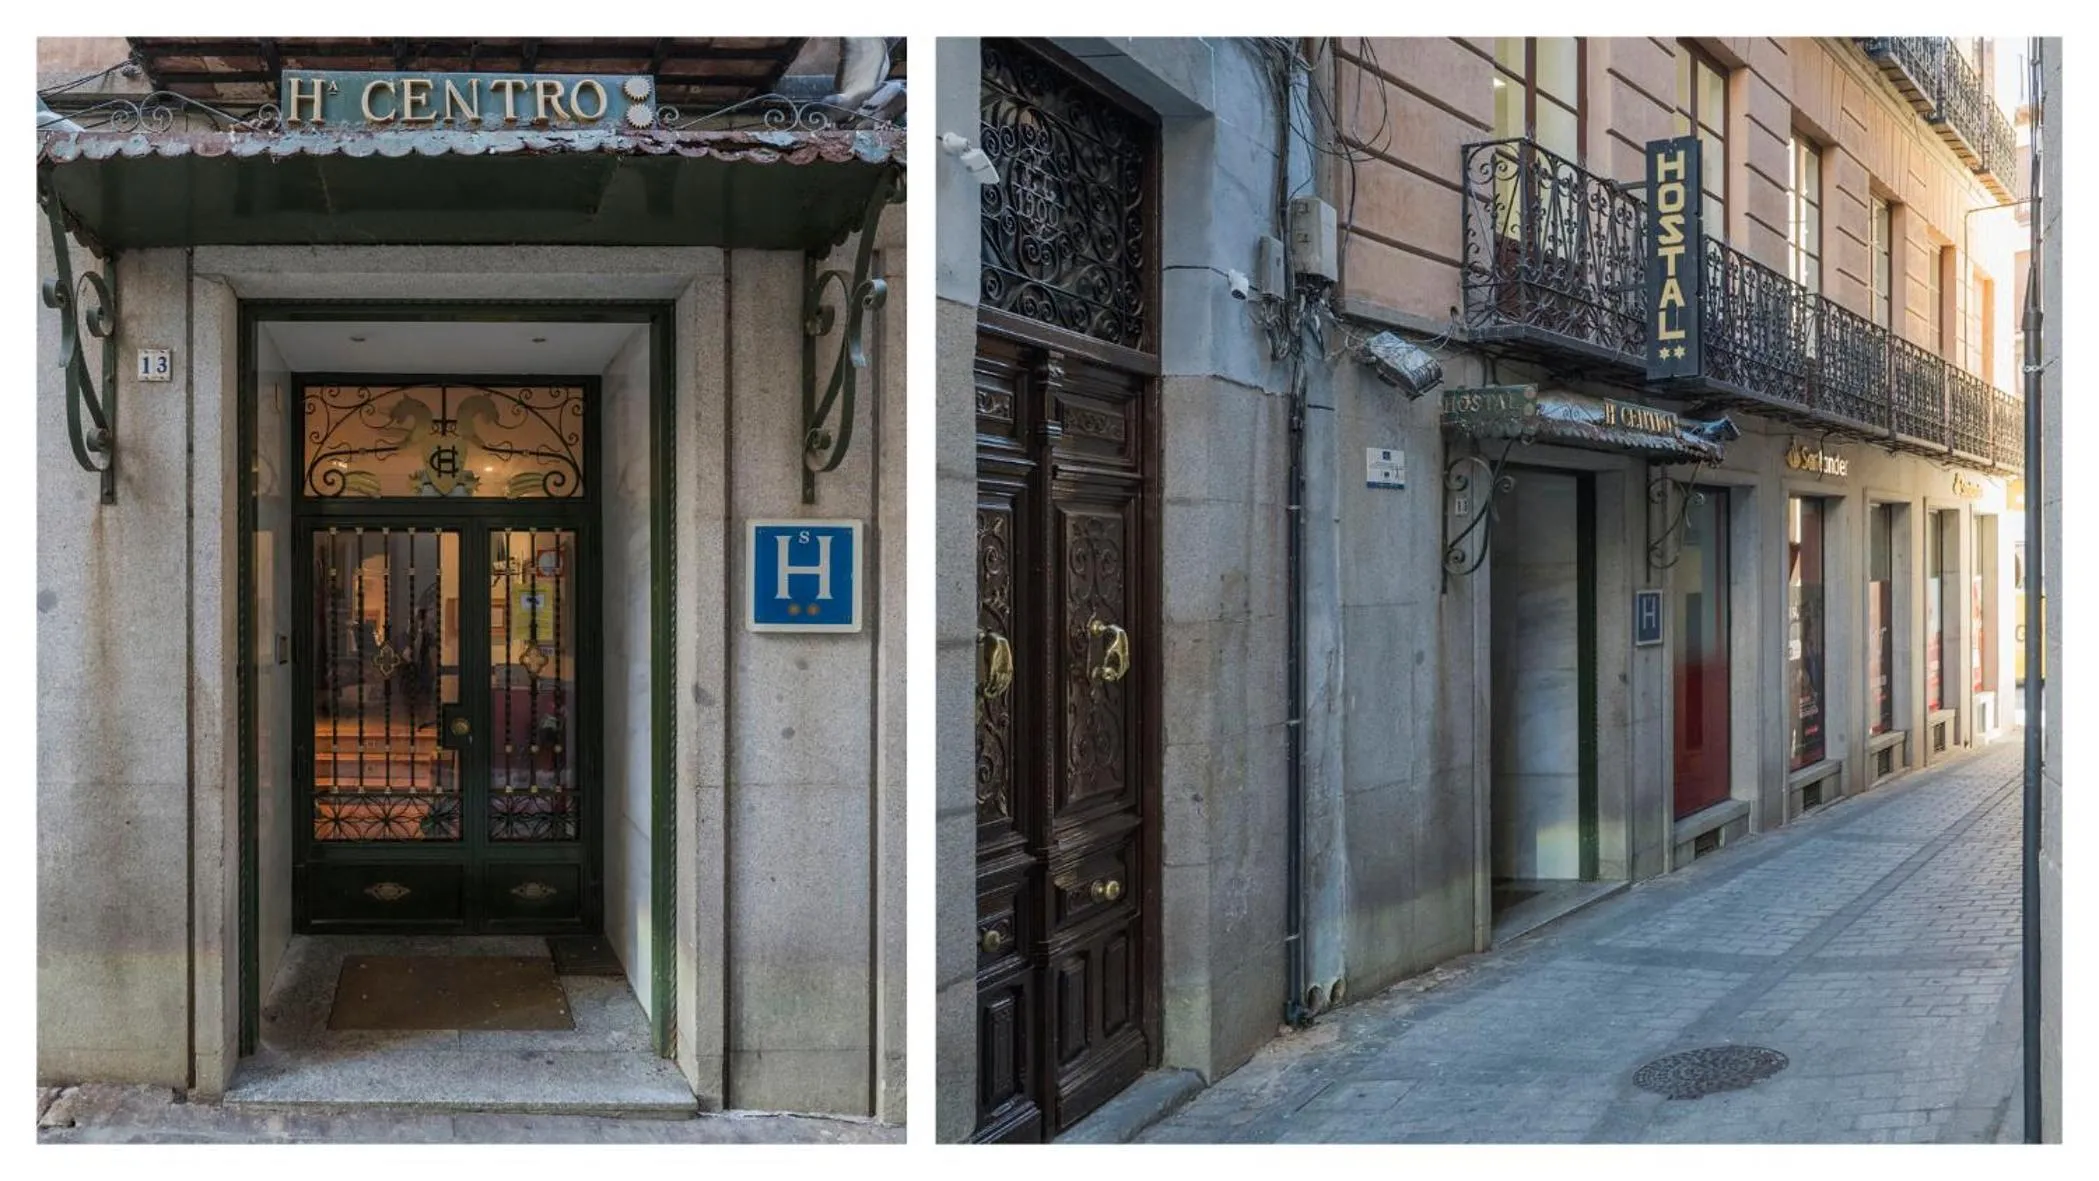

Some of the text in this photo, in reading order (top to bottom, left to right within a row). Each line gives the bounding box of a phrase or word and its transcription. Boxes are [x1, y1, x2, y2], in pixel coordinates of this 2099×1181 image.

[361, 78, 608, 123] CENTRO
[1656, 150, 1686, 341] HOSTAL
[142, 356, 167, 374] 13
[774, 535, 834, 600] H
